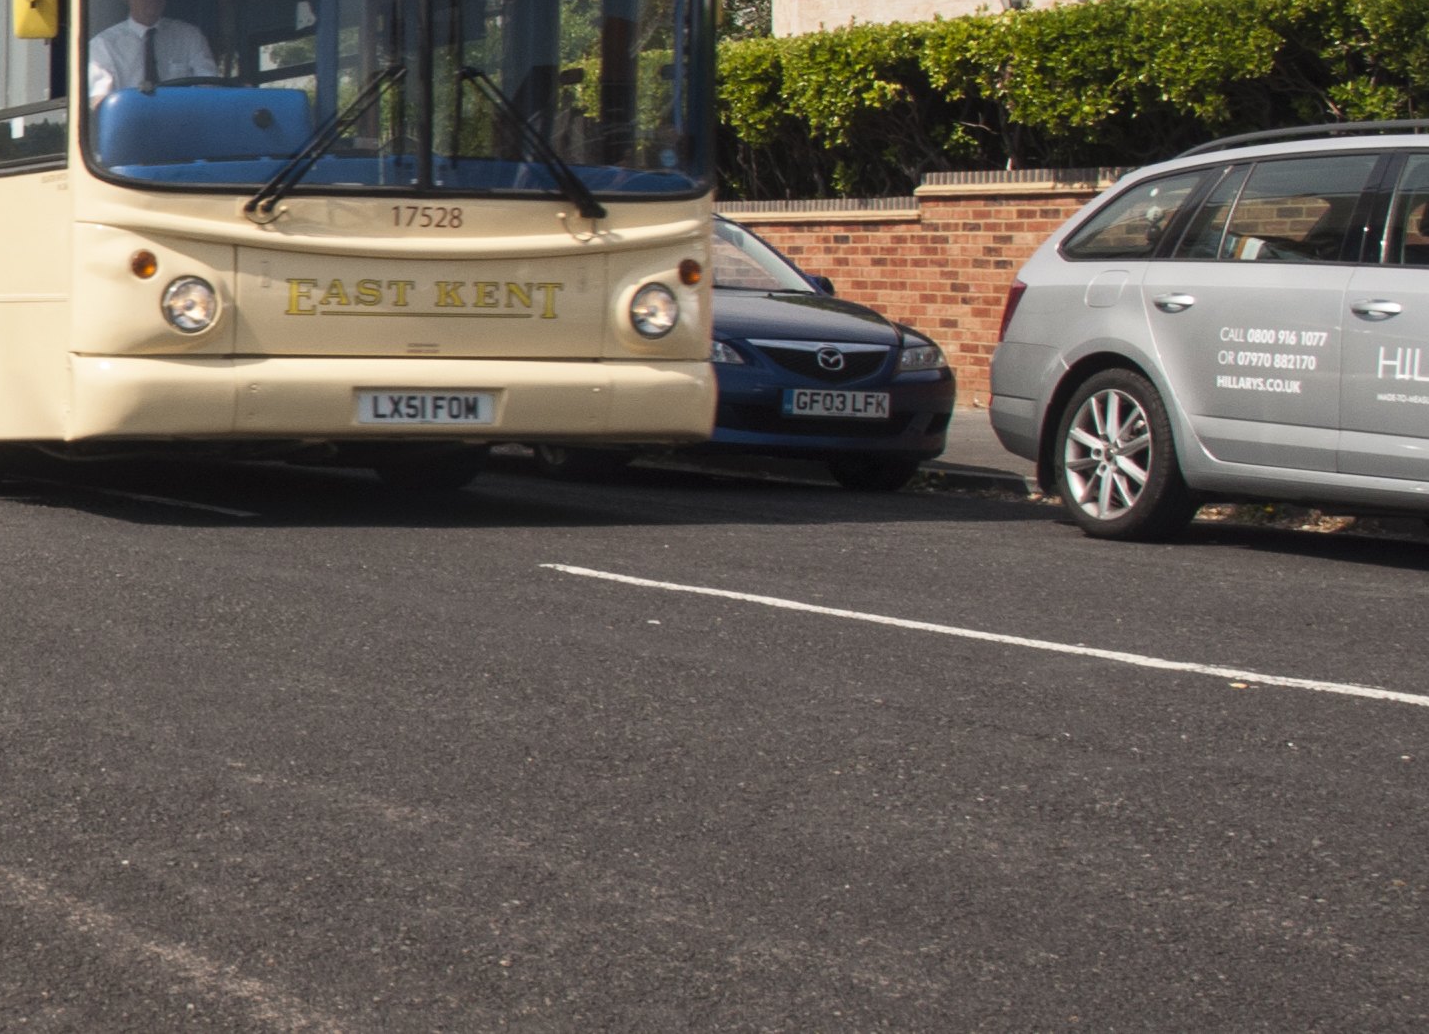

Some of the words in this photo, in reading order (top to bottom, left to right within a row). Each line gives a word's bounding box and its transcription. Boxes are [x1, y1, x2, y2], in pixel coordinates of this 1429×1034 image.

[391, 205, 464, 229] 17528
[284, 277, 416, 317] EAST
[434, 279, 565, 320] KENT
[1219, 326, 1245, 343] CALL
[1246, 328, 1276, 345] 0800
[1277, 329, 1298, 346] 916
[1300, 331, 1328, 347] 1077
[1217, 349, 1236, 366] OR
[1236, 351, 1273, 368] 07970
[1273, 353, 1317, 371] 882170
[1377, 345, 1429, 382] HIL
[1216, 374, 1302, 394] HILLARYS.CO.UK
[371, 394, 427, 420] LX51
[432, 395, 480, 420] FOM
[795, 391, 847, 413] GF03
[851, 393, 887, 415] LFK
